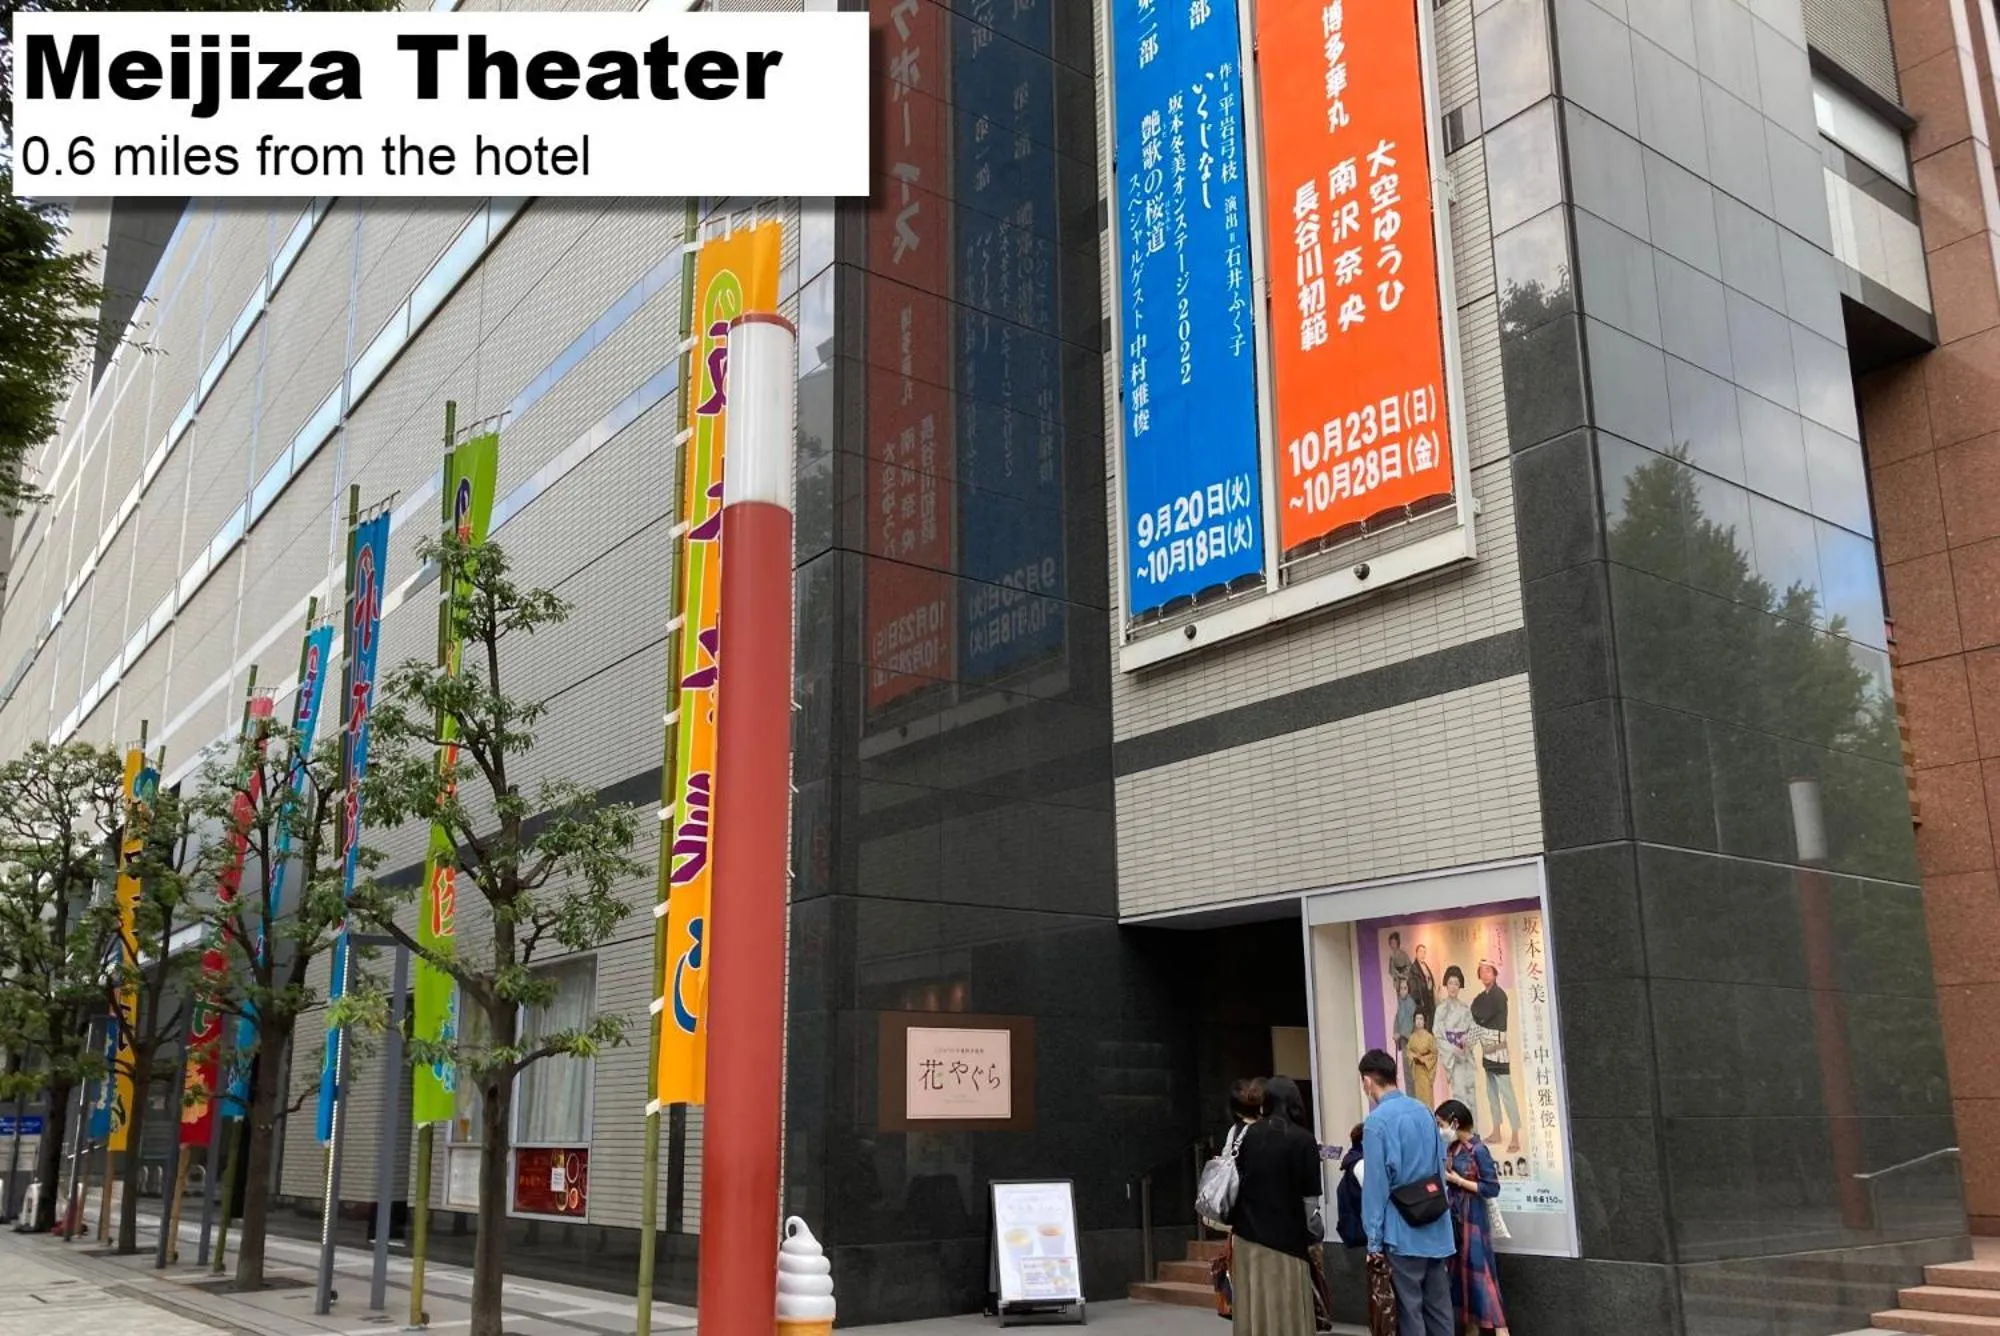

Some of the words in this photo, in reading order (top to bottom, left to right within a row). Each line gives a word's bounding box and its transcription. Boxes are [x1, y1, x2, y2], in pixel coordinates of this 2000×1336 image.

[1322, 0, 1350, 133] 博多華丸
[1191, 72, 1216, 210] いくじなし
[1293, 179, 1328, 352] 長谷川初範
[1328, 157, 1365, 331] 南沢奈央
[1367, 139, 1405, 312] 大空ゆうひ
[1289, 384, 1437, 478] 10月23日(日)
[1137, 473, 1252, 549] 9月20日(火)
[1523, 917, 1545, 1003] 坂本冬美
[919, 1059, 1000, 1092] 花やぐら
[1534, 1046, 1556, 1129] 中村雅俊
